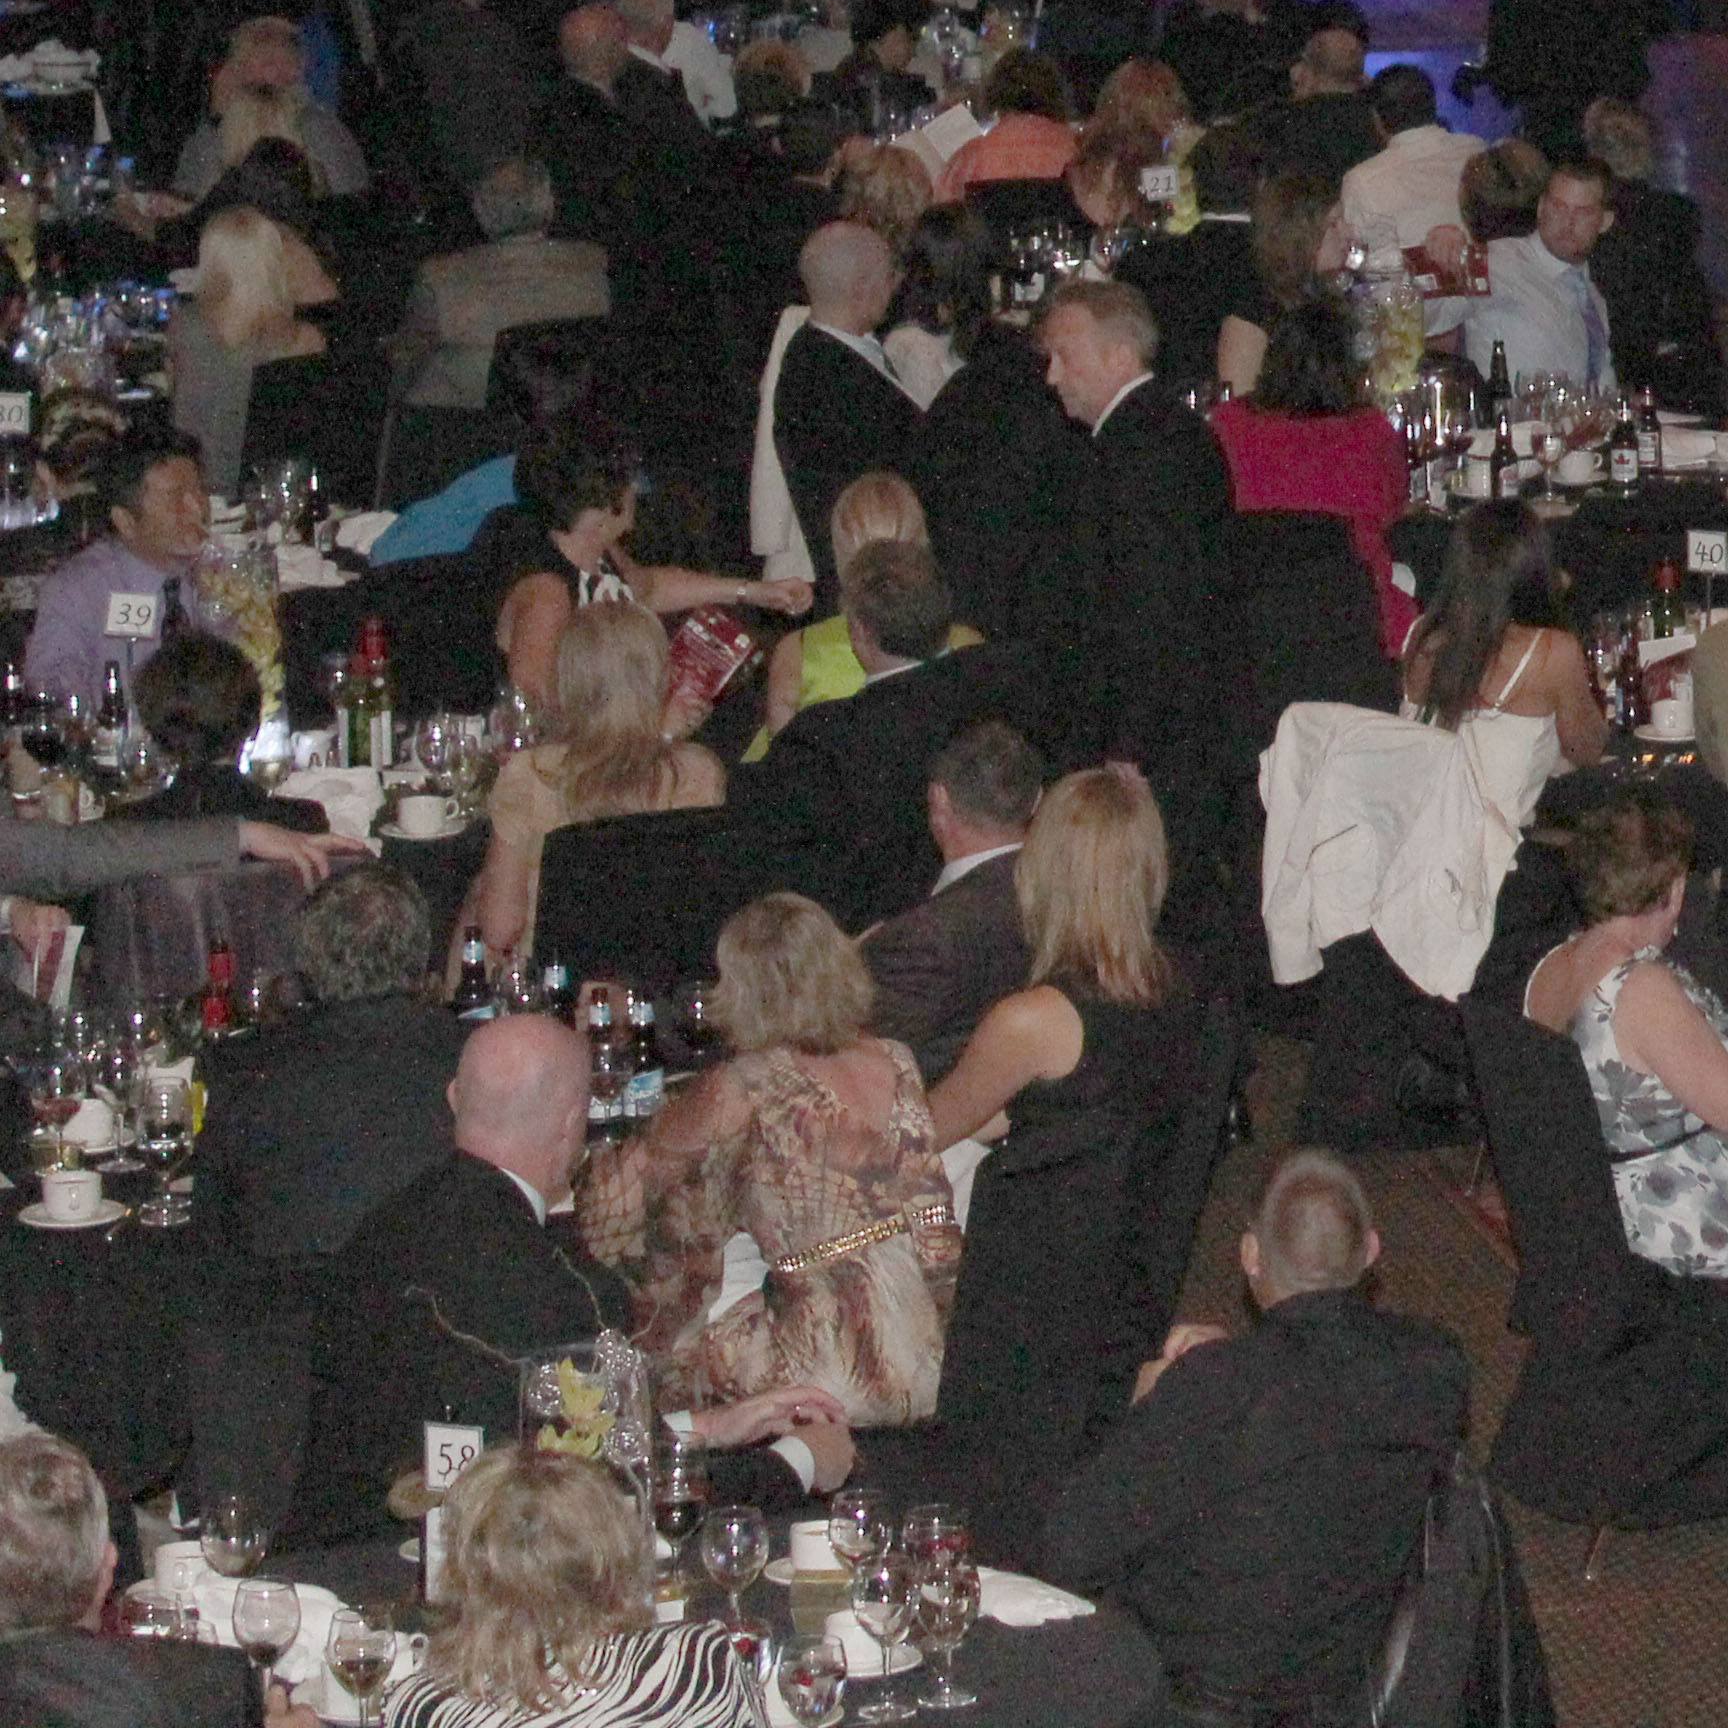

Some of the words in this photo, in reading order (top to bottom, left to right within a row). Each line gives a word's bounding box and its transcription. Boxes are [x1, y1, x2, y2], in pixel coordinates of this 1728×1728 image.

[1149, 176, 1174, 193] 21
[1695, 540, 1725, 564] 40
[115, 603, 153, 628] 39
